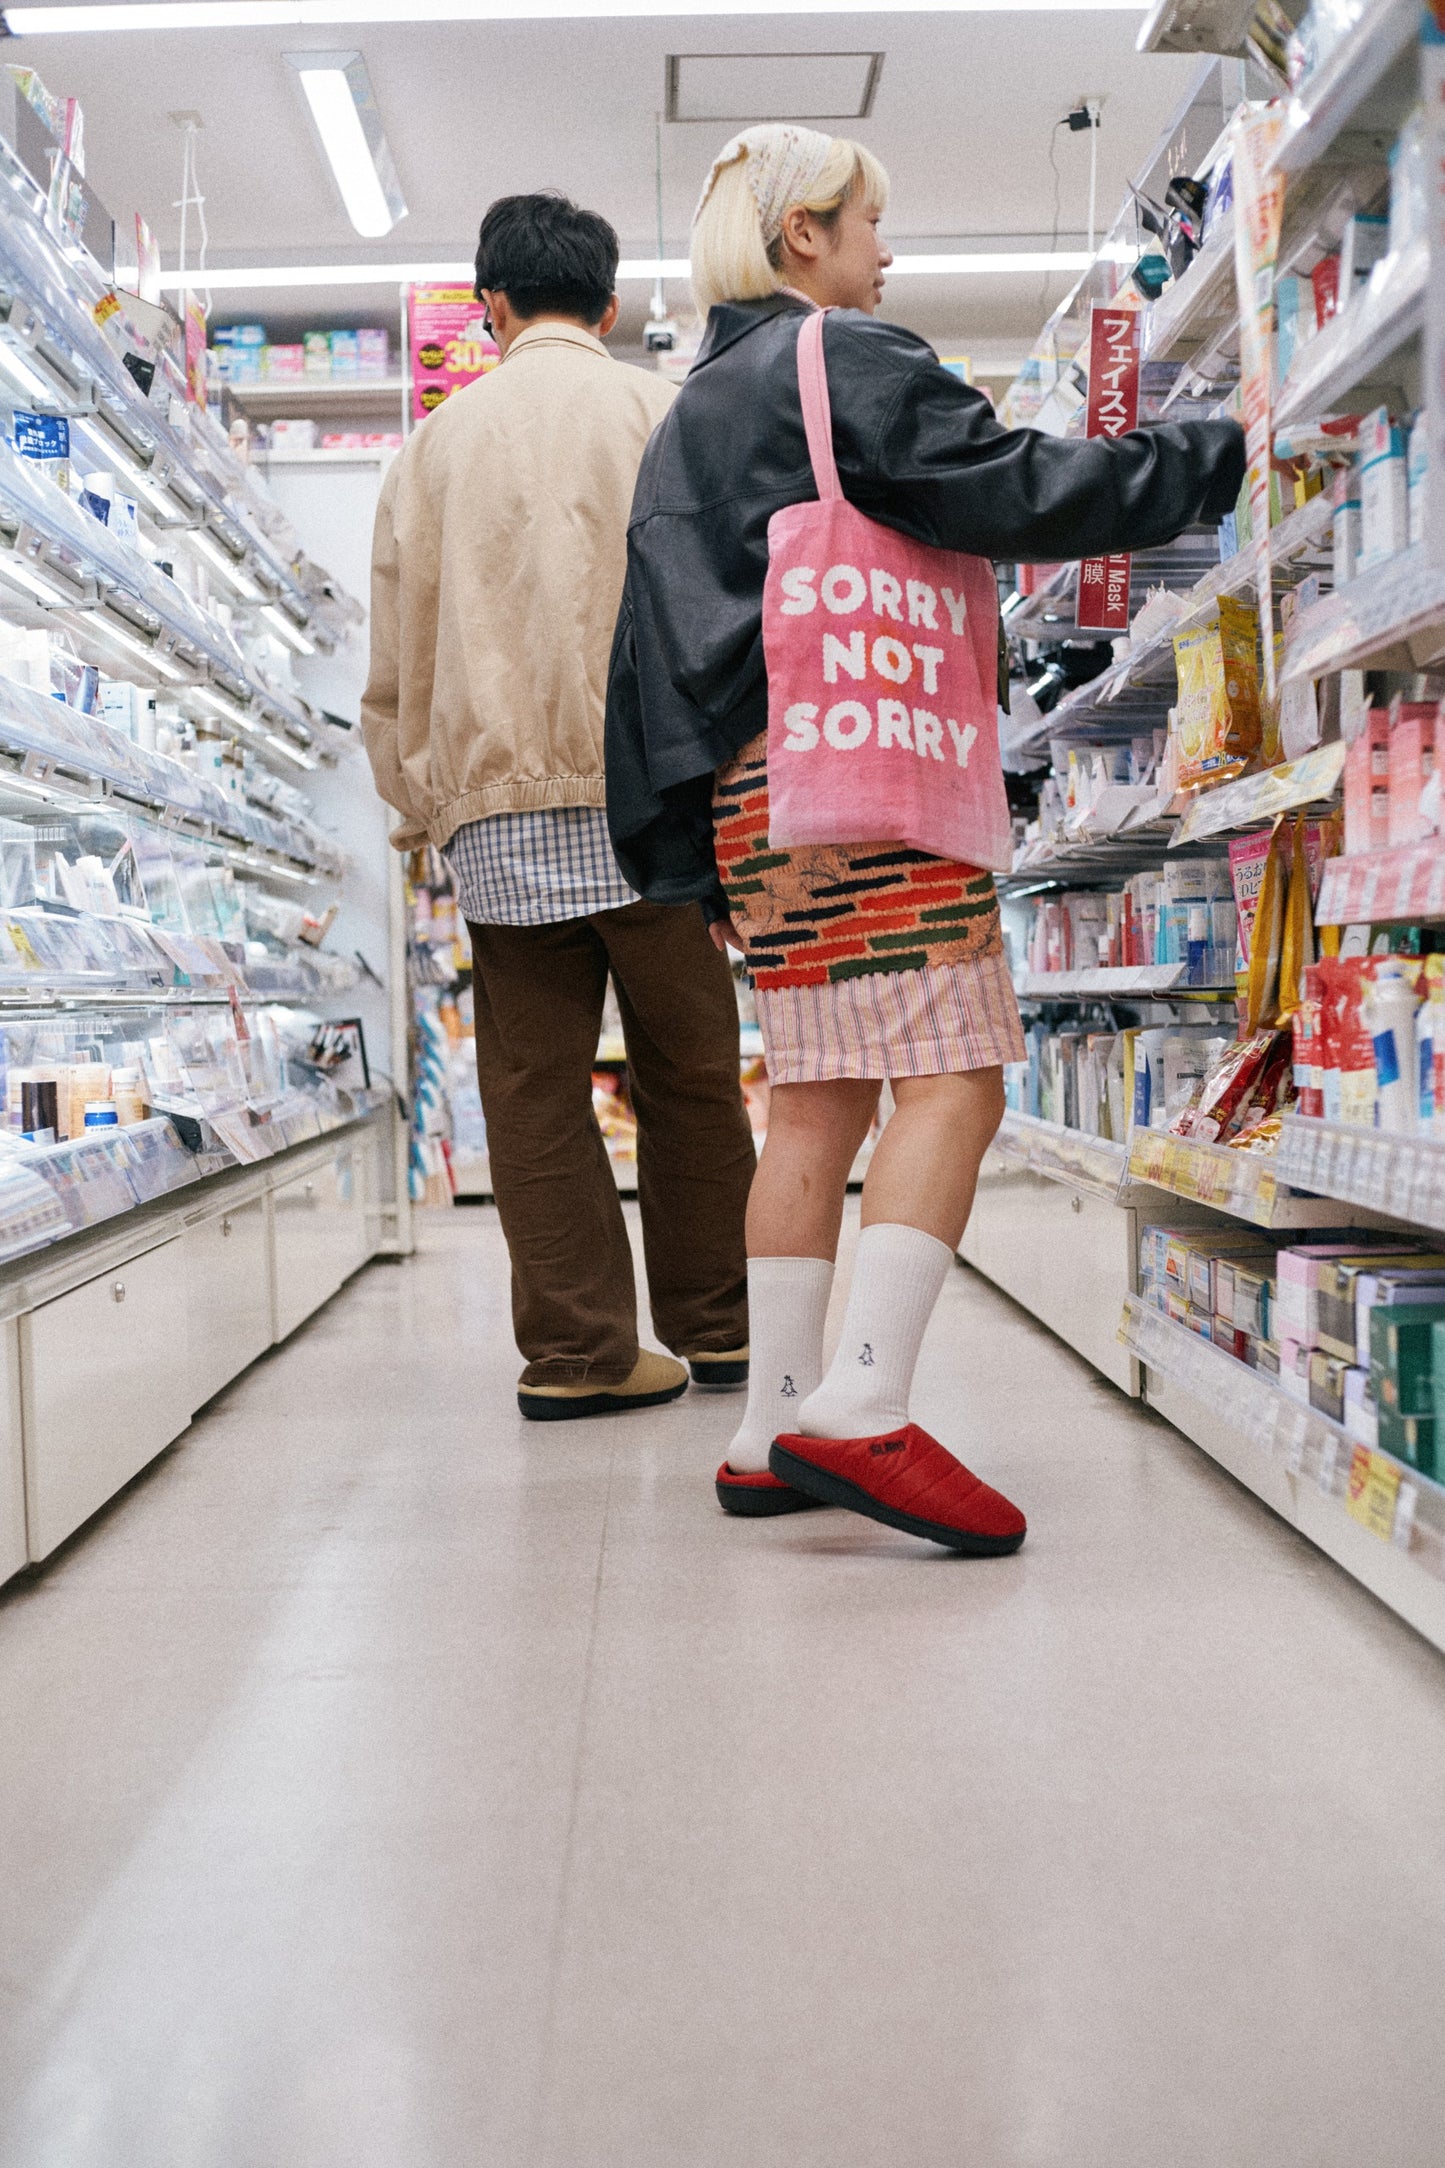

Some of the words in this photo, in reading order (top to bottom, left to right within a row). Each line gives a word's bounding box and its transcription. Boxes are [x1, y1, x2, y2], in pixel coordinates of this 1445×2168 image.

[1098, 318, 1133, 437] フェイスマ
[779, 563, 968, 635] SORRY
[1083, 556, 1105, 585] 膜
[1107, 569, 1127, 612] Mask
[822, 630, 945, 696] NOT
[782, 698, 978, 768] SORRY
